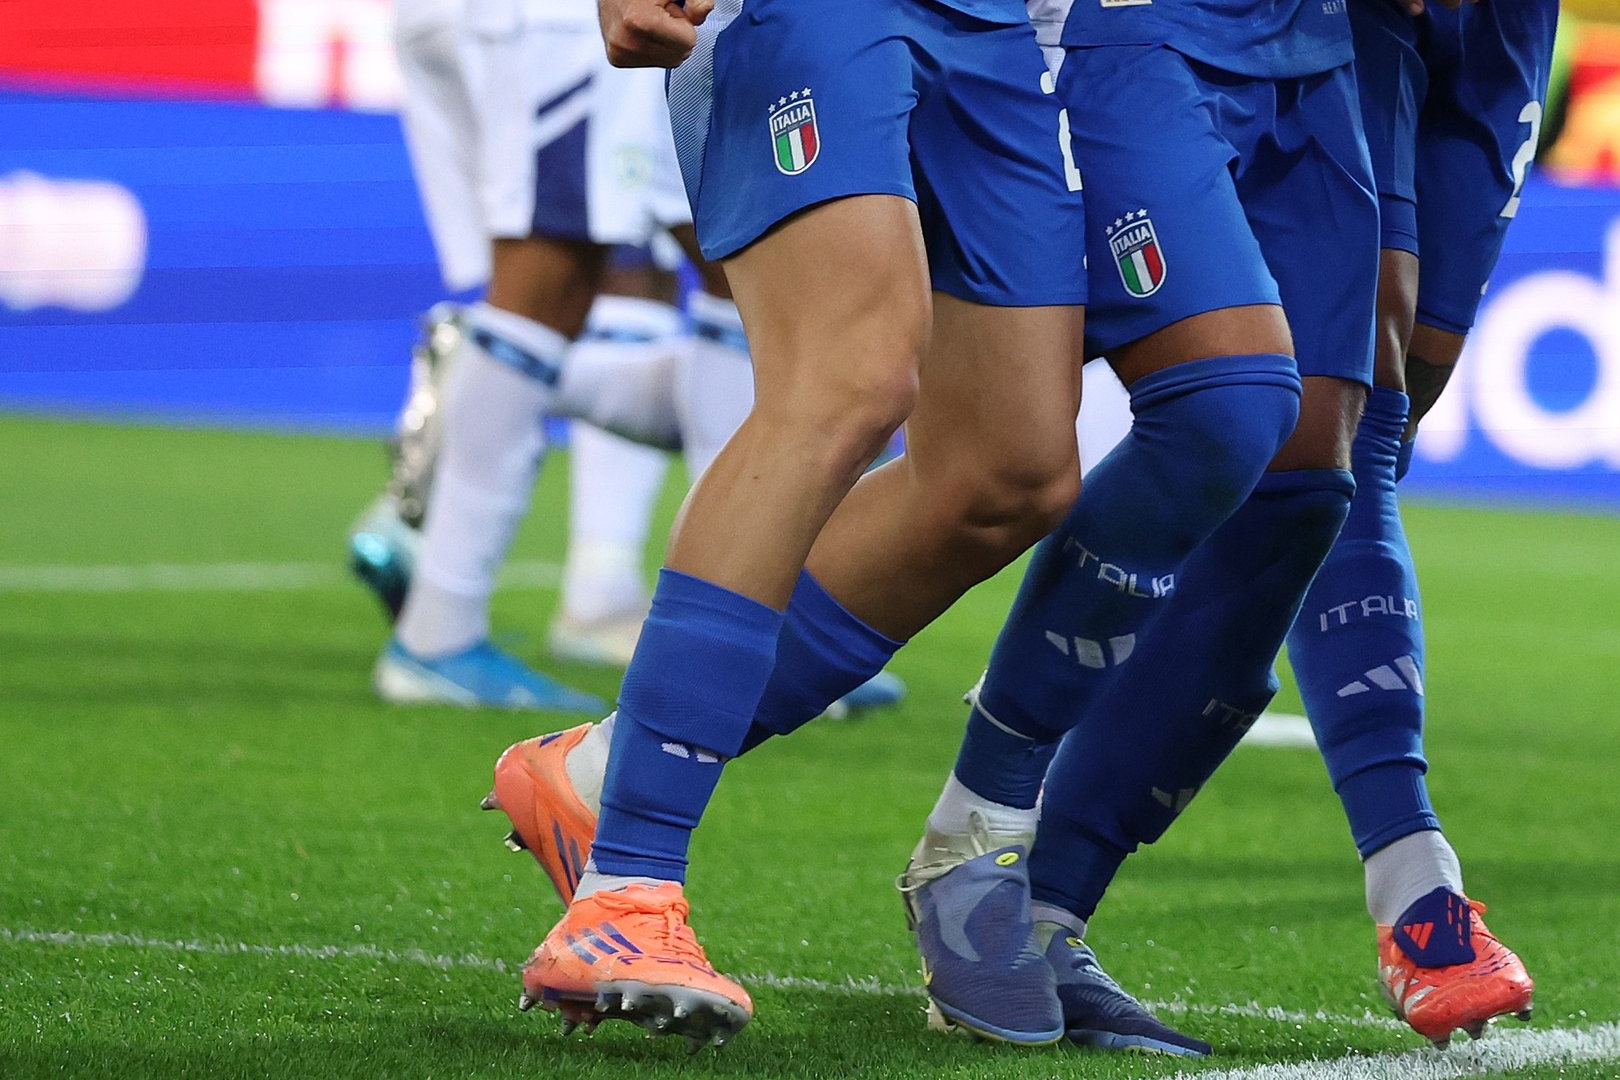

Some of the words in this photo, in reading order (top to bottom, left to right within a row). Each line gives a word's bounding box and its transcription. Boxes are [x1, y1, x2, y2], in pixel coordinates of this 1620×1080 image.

[773, 105, 811, 133] ITALIA
[1112, 224, 1152, 255] ITALIA
[1063, 536, 1175, 598] ITALIA
